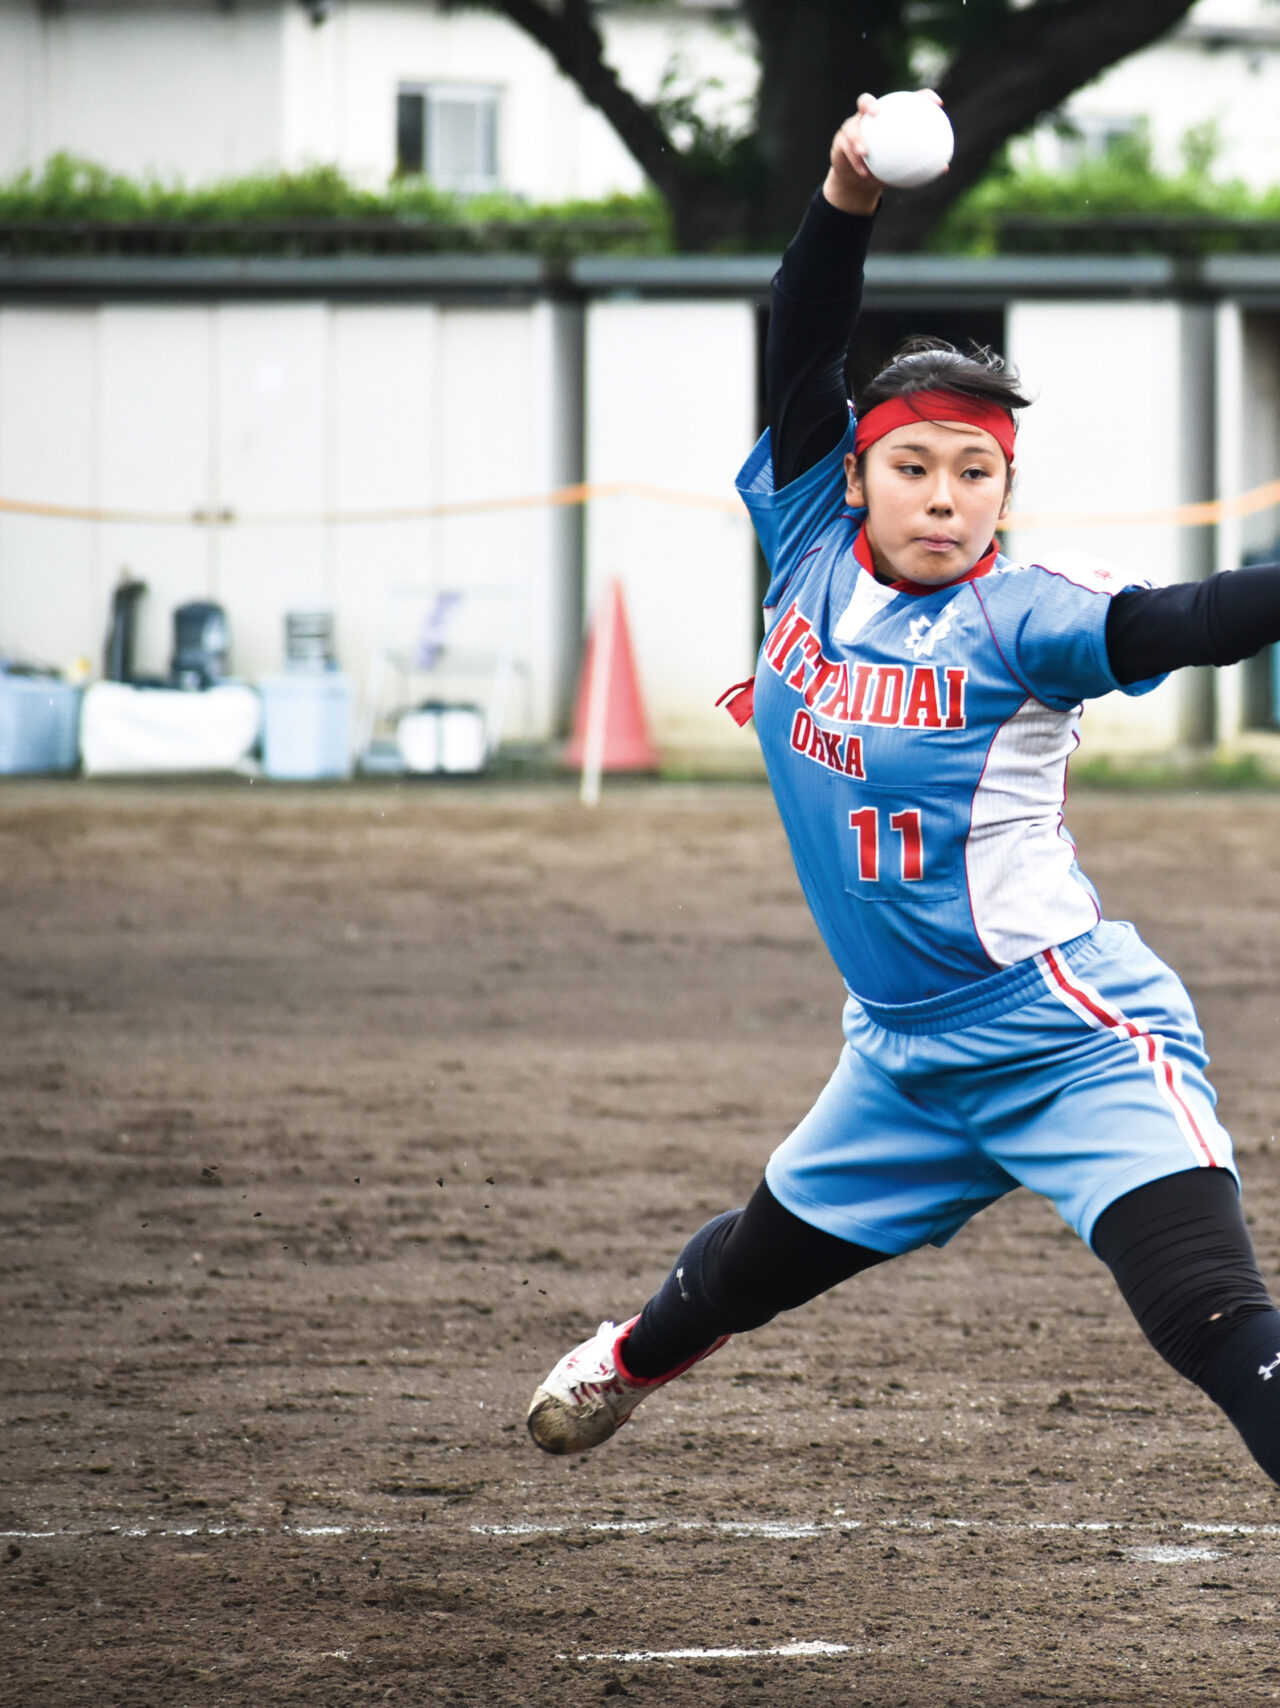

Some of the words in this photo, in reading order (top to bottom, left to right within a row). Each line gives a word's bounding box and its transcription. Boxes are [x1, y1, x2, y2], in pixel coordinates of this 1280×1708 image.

[763, 597, 968, 730] NITTAIDAI
[790, 708, 867, 781] OHKA
[850, 806, 924, 881] 11
